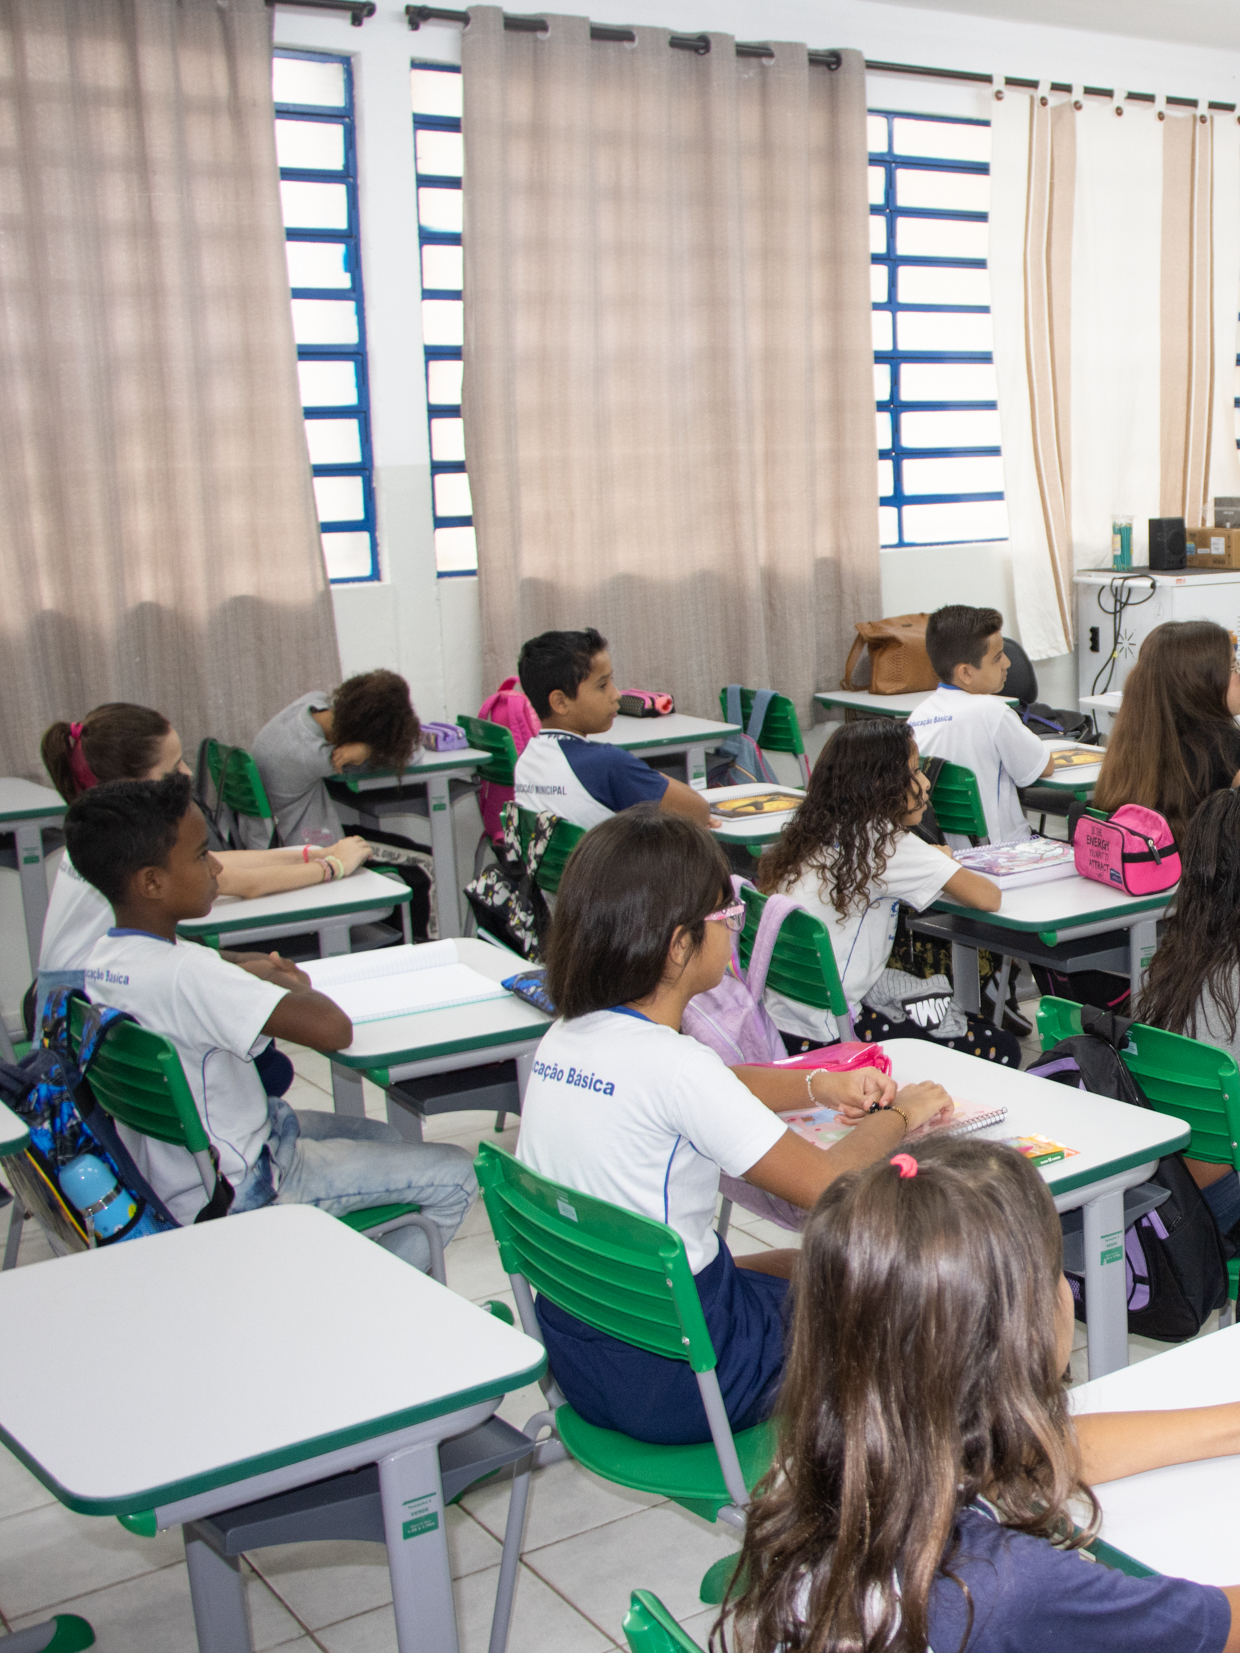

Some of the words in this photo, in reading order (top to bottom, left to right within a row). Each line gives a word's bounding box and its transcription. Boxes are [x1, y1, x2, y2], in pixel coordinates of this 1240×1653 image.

[1087, 834, 1110, 852] ENERGY
[1089, 858, 1110, 873] ATTRACT
[533, 1060, 564, 1082] cação
[566, 1067, 616, 1097] Básica
